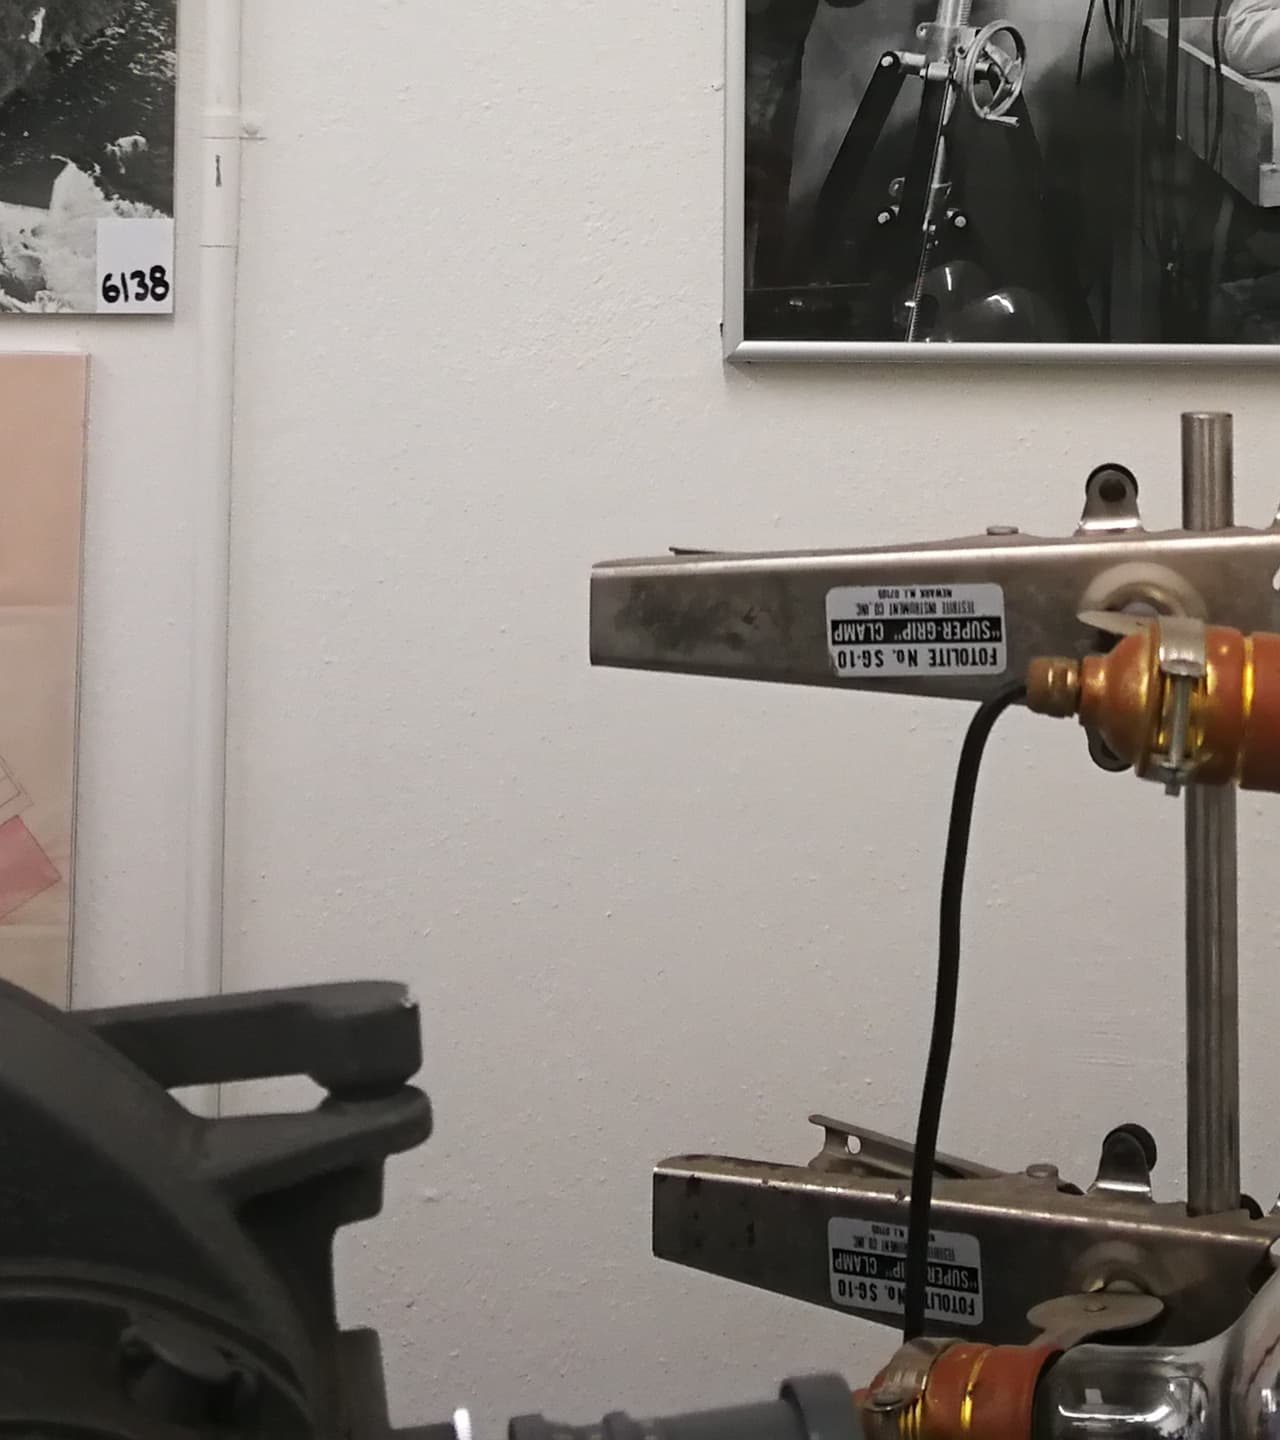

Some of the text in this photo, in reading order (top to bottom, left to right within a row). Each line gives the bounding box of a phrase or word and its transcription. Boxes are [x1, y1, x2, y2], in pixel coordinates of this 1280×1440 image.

[101, 264, 170, 304] 6138
[888, 600, 937, 617] INSTRUMENT
[833, 621, 885, 642] CLAMP
[892, 648, 919, 668] No.
[927, 647, 998, 668] FOTOLITE
[834, 1251, 878, 1275] CLAMP
[924, 1291, 976, 1317] FOTOLIT
